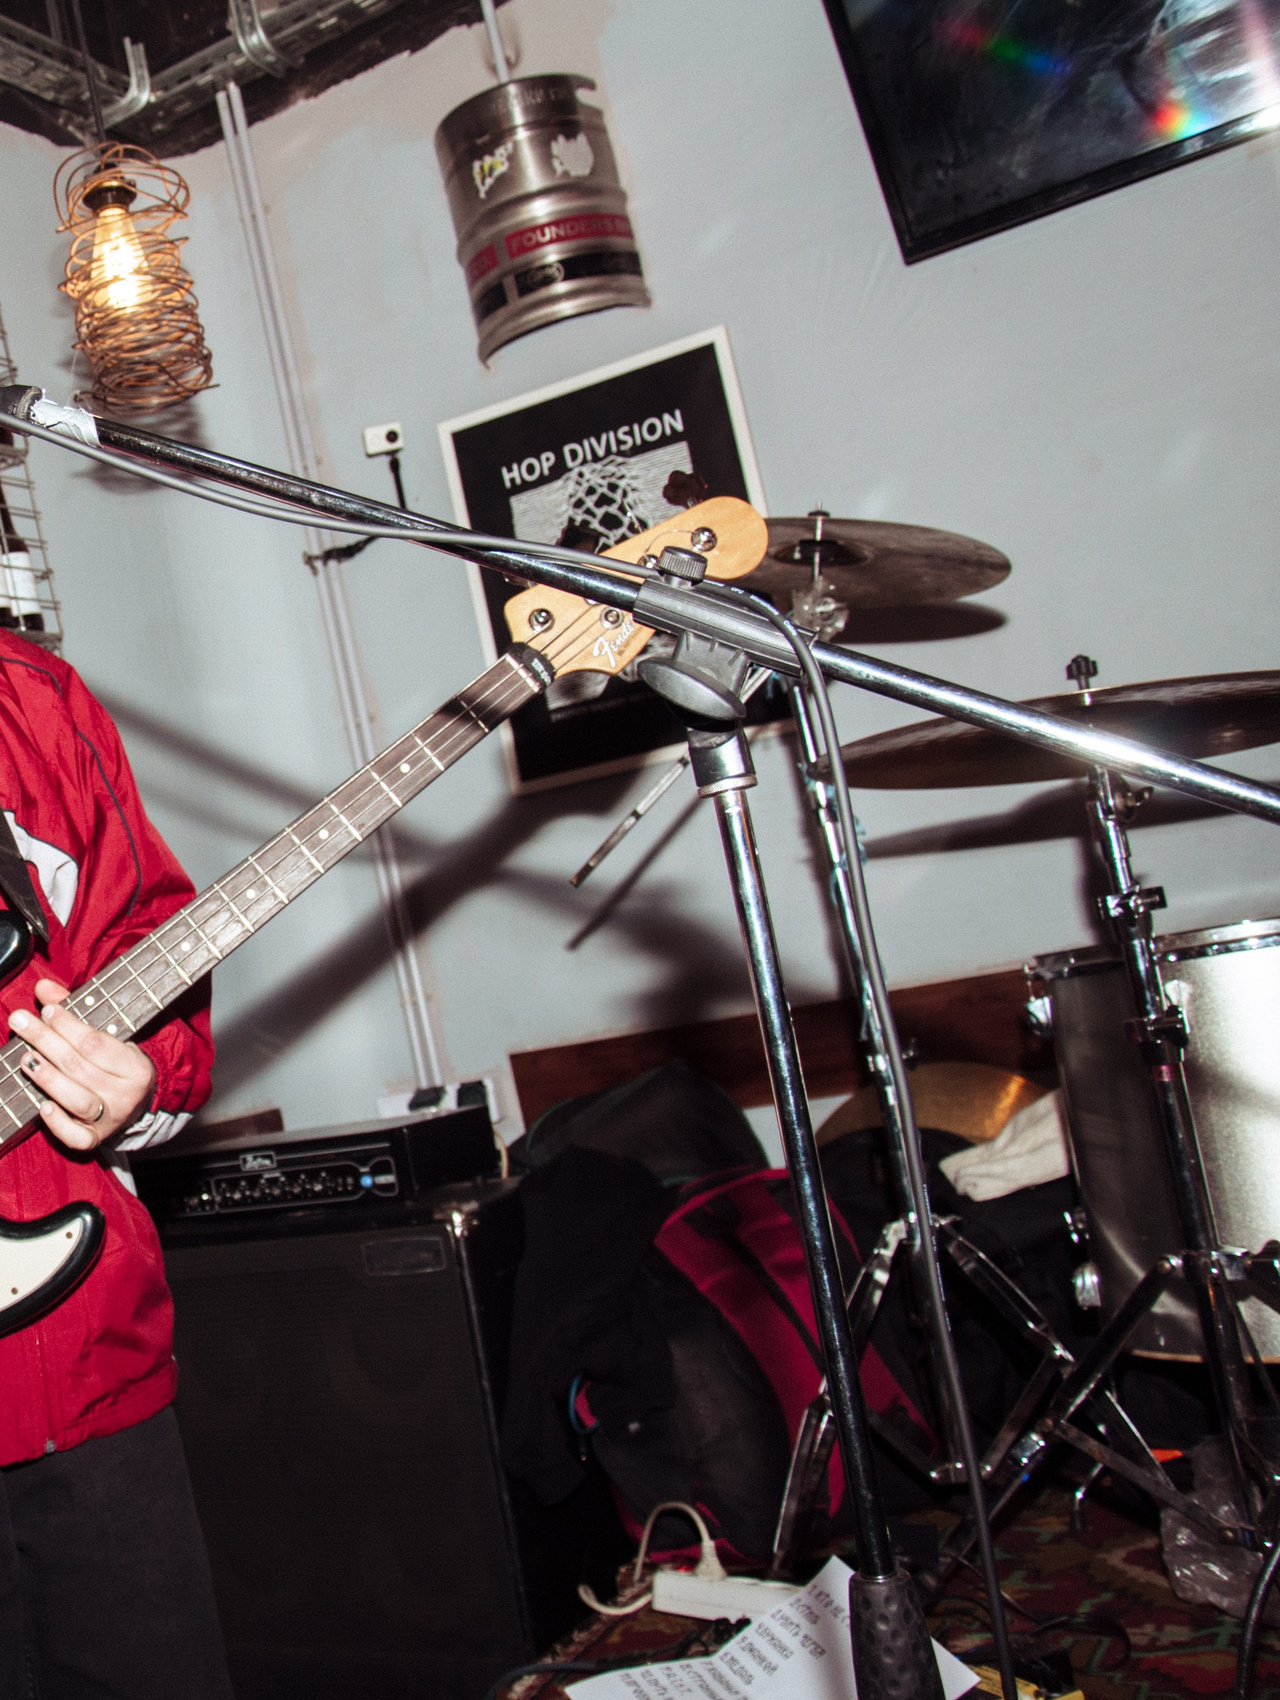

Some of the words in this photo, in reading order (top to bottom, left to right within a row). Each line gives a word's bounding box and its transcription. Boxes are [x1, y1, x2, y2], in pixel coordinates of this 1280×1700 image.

[501, 451, 556, 489] HOP
[563, 408, 685, 469] DIVISION
[592, 619, 637, 668] Fende
